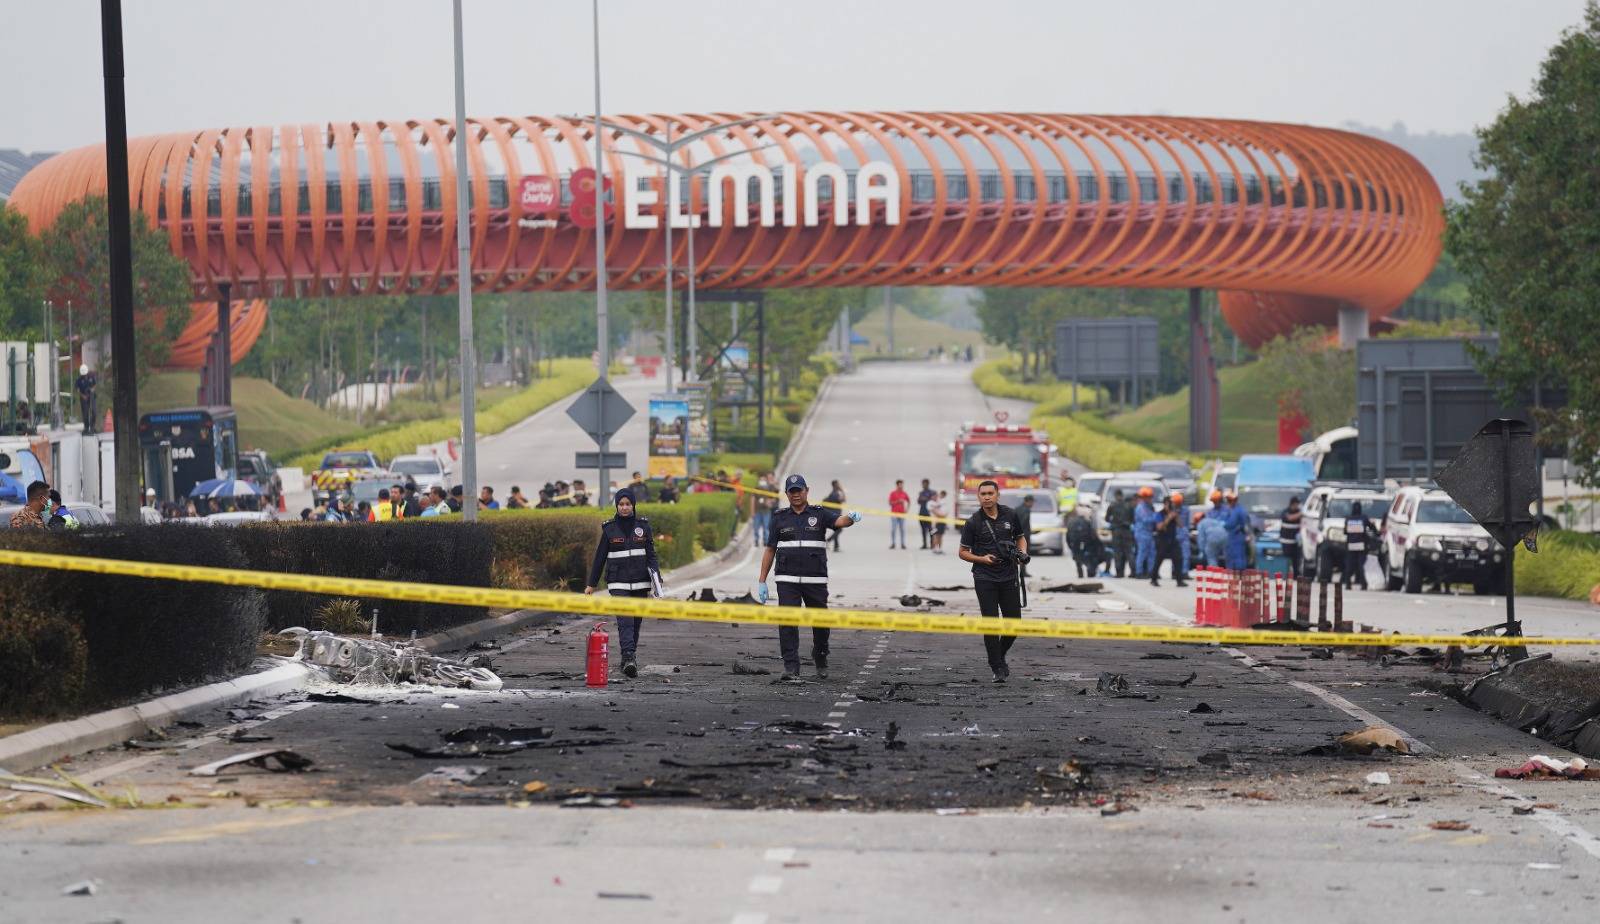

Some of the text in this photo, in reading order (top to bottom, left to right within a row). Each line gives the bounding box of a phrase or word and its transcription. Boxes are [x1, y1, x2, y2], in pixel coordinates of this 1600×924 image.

[522, 191, 554, 206] Darby
[624, 161, 900, 230] ELMINA
[172, 447, 195, 459] BSA
